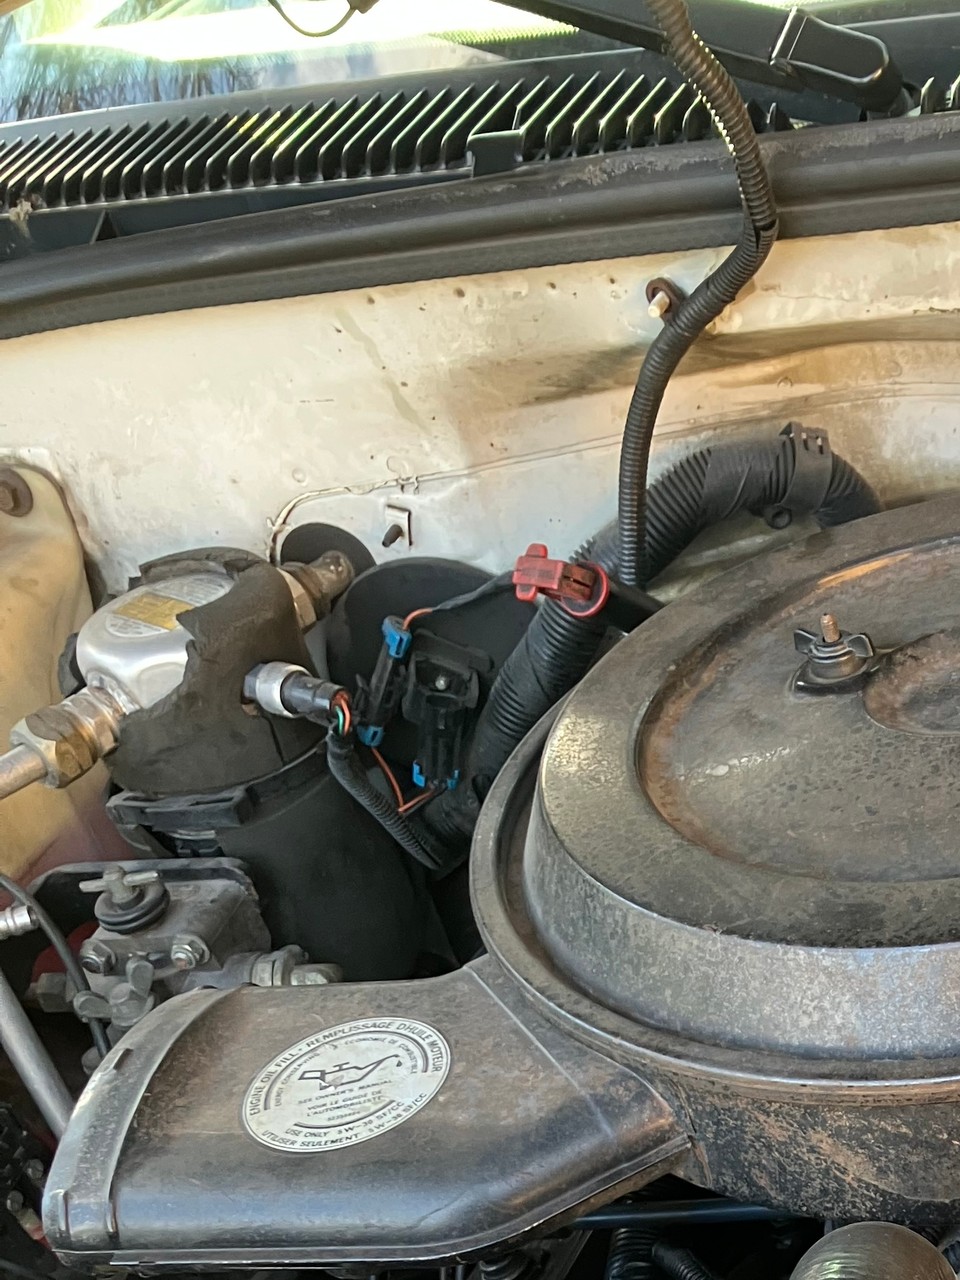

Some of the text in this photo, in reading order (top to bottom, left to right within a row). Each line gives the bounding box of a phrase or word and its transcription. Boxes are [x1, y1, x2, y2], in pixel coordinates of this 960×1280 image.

[249, 1085, 267, 1116] ENGINE
[261, 1069, 279, 1084] OIL
[274, 1052, 299, 1068] FILL
[305, 1021, 395, 1048] REMPLISSAGE
[426, 1039, 444, 1073] MOTEUR
[284, 1127, 304, 1137] USE
[304, 1130, 331, 1138] ONLY
[299, 1132, 361, 1147] SEULEMENT
